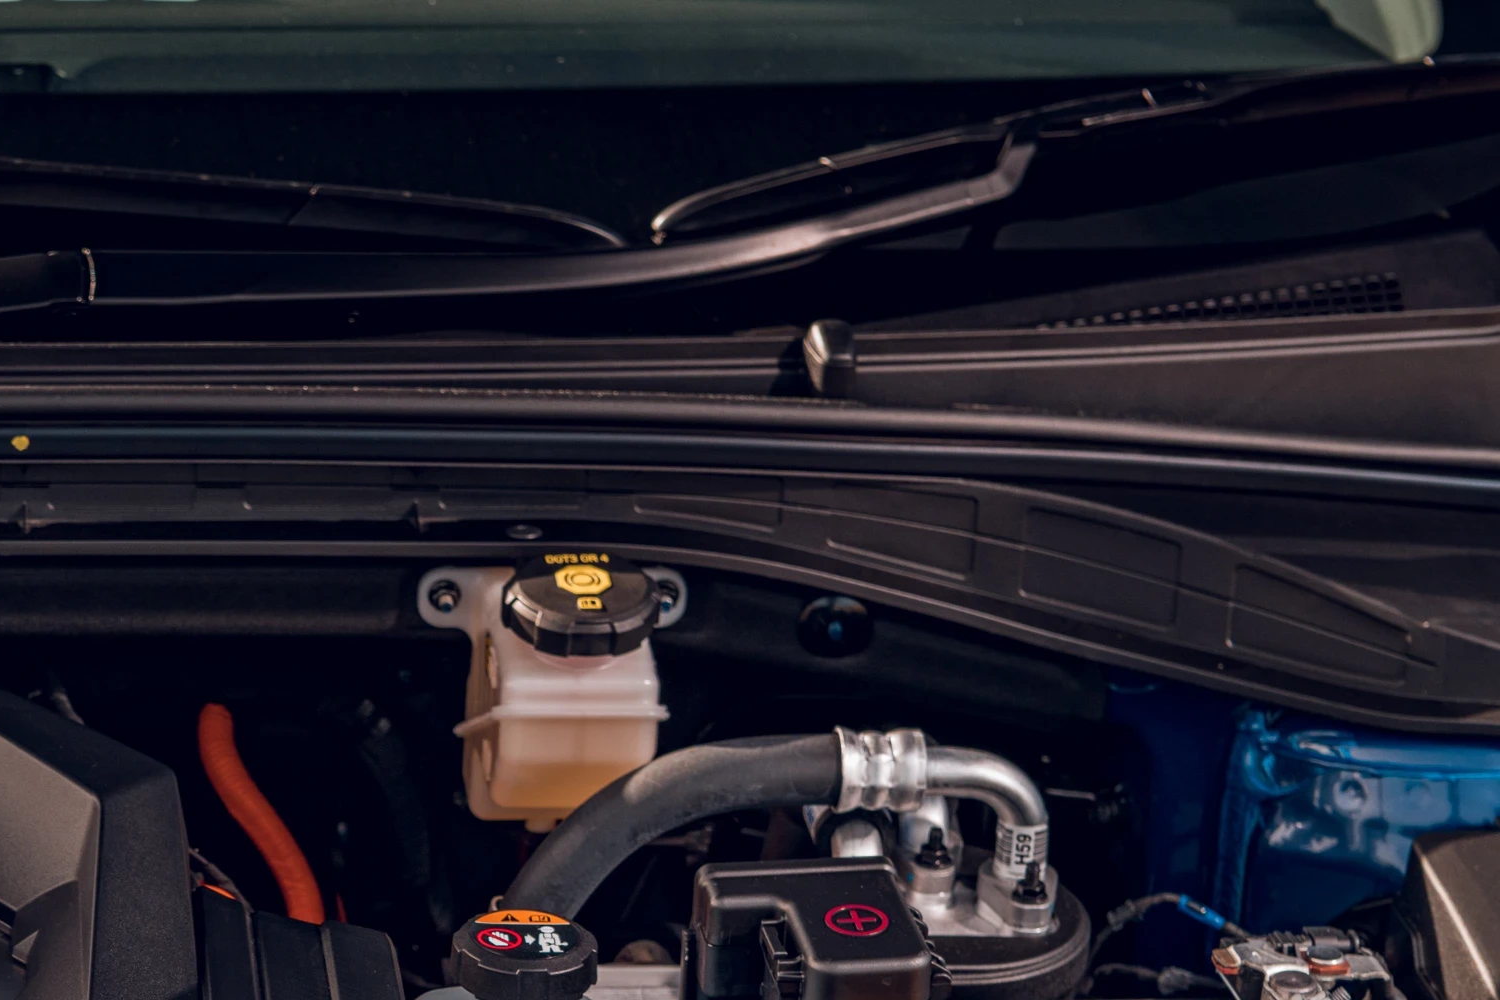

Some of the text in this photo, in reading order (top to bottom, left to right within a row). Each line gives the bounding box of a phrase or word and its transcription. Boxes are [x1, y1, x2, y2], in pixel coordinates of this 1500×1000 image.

[545, 553, 610, 564] DOT3 OR 4
[1014, 833, 1032, 865] H59
